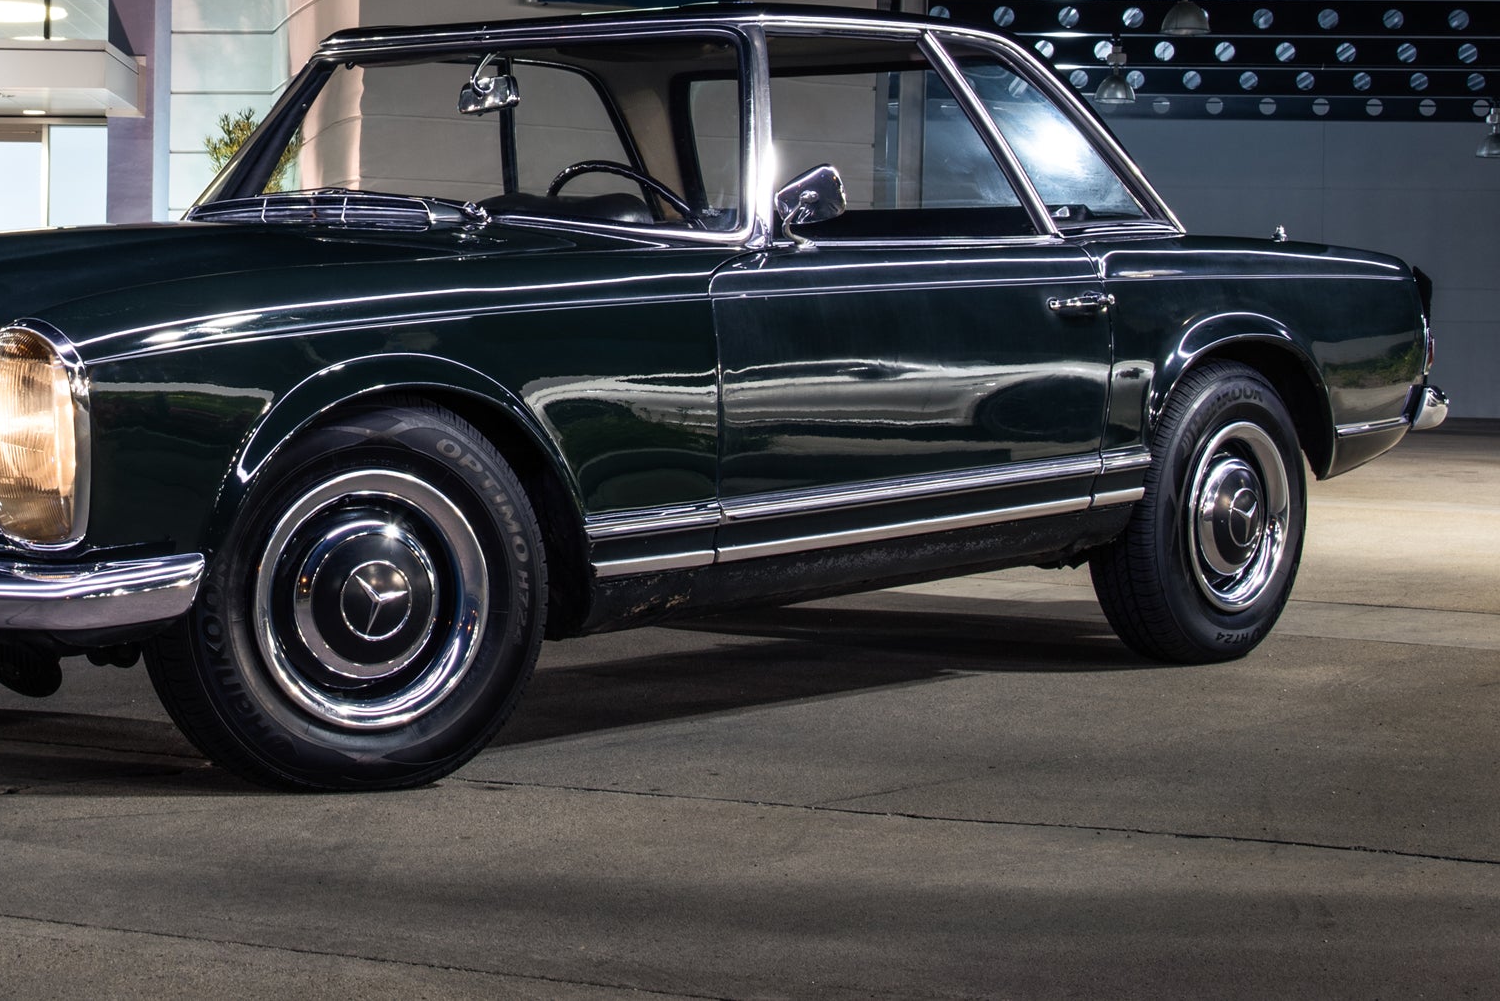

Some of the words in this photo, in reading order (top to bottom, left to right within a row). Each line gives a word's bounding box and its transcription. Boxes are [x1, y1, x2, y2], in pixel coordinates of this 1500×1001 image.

[435, 438, 530, 563] OPTIMO
[512, 569, 530, 646] H724
[1215, 631, 1249, 645] H724
